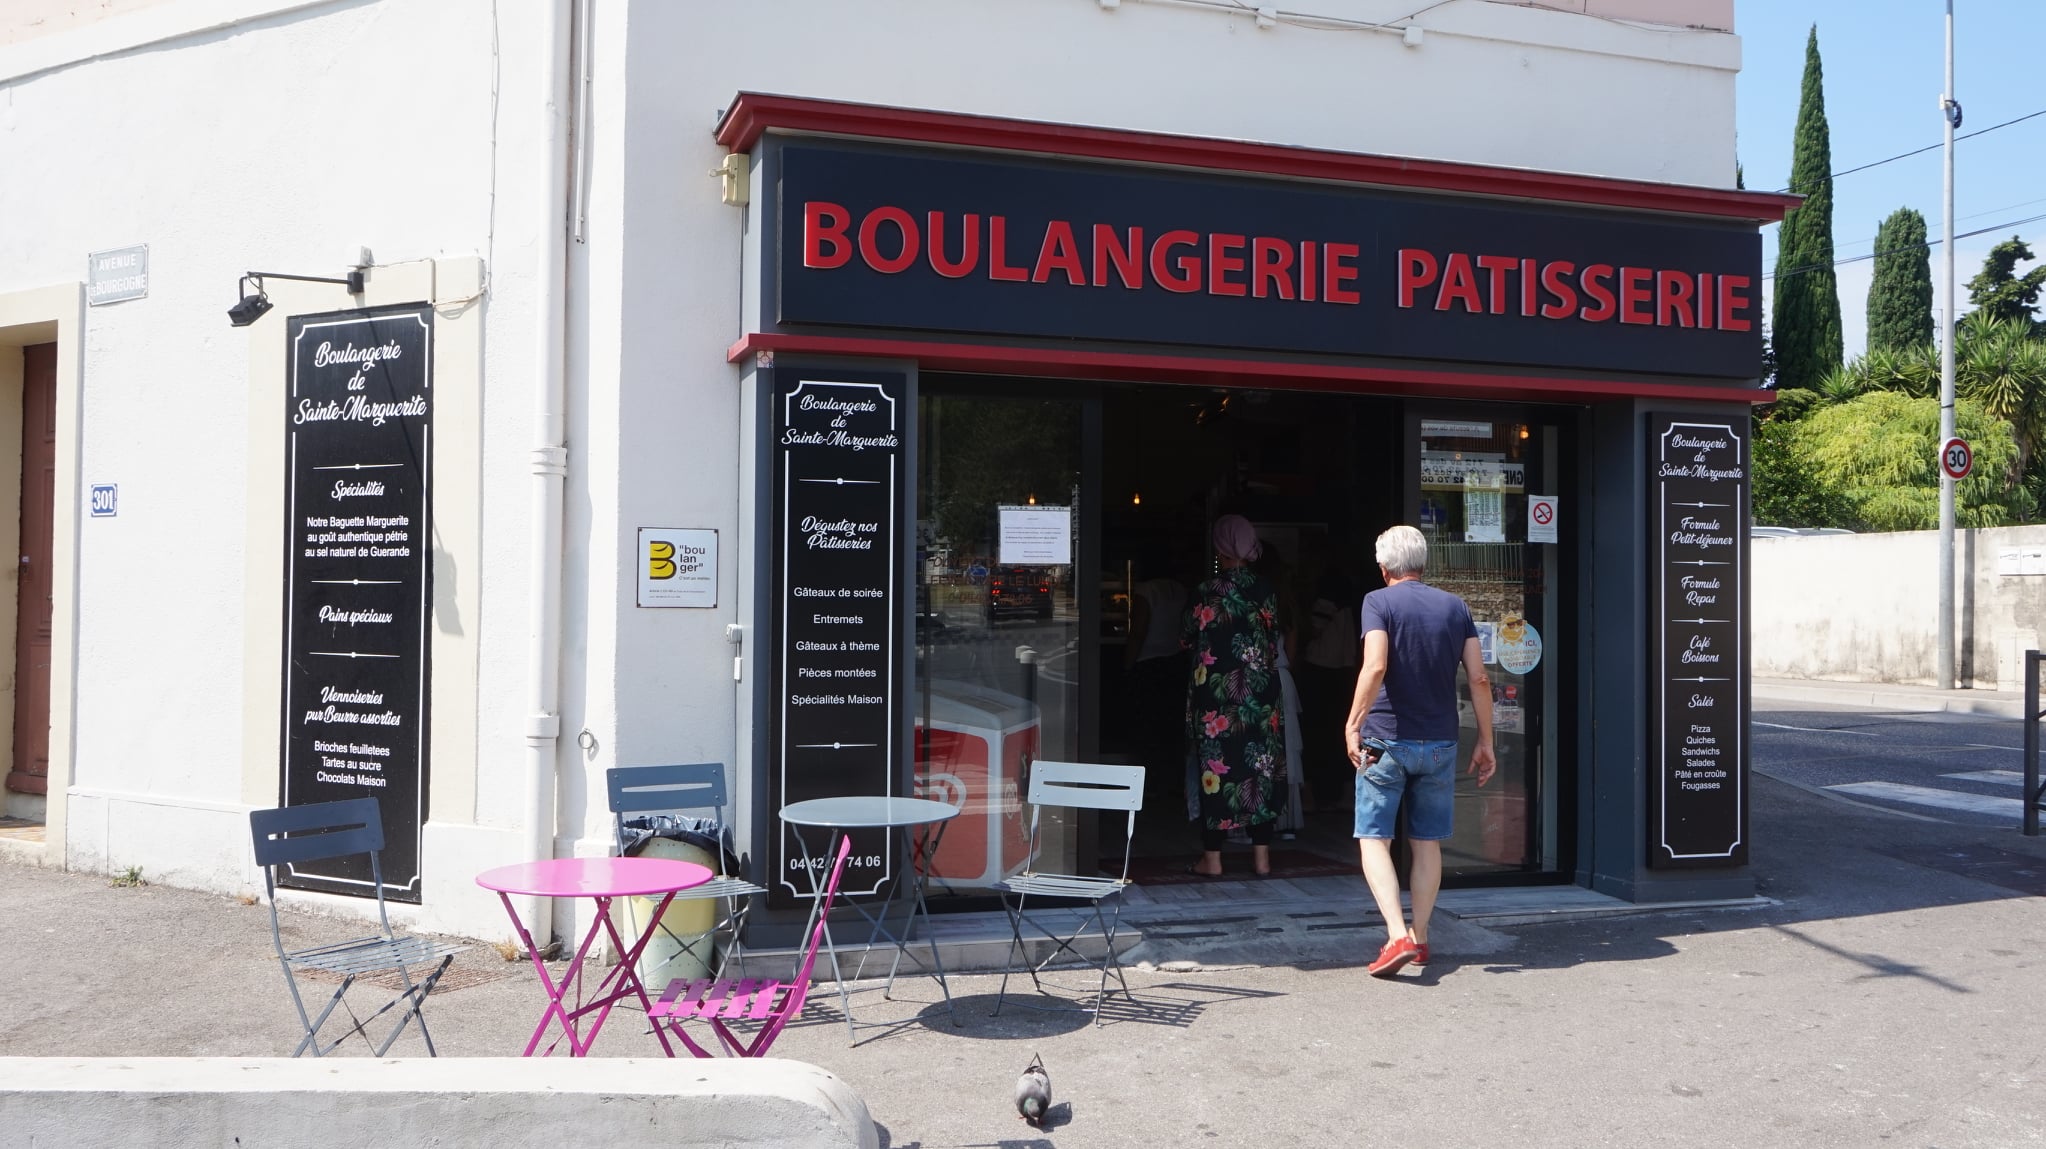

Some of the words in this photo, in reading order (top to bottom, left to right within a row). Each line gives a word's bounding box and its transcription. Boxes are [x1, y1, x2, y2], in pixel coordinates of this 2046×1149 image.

[99, 254, 136, 271] AVENUE
[803, 201, 1360, 304] BOULANGERIE
[1398, 249, 1751, 331] PATISSERIE
[96, 274, 146, 295] BOURGOGNE
[314, 339, 402, 371] Boulangerie
[347, 370, 365, 391] de
[293, 394, 427, 427] Sainte-Marguerite
[800, 394, 877, 416] Boulangerie
[831, 415, 847, 428] de
[781, 429, 899, 451] Sainte-Marguerite
[1671, 434, 1727, 452] Boulangerie
[1694, 451, 1706, 462] de
[1948, 450, 1967, 468] 30
[1658, 462, 1743, 482] Sainte-Marguerite
[331, 480, 385, 501] Spécialités
[94, 490, 113, 510] 301
[307, 517, 328, 527] Notre
[330, 516, 364, 529] Baguette
[366, 515, 409, 528] Marguerite
[801, 516, 856, 537] Dégustez
[858, 523, 878, 533] nos
[1681, 516, 1720, 530] Formule
[307, 534, 317, 542] au
[319, 532, 336, 544] goût
[338, 531, 383, 543] authentique
[385, 530, 408, 543] pétrie
[807, 534, 872, 550] Pâtisseries
[1671, 531, 1733, 549] Petit-déjeuner
[305, 549, 315, 557] au
[316, 547, 328, 557] sel
[330, 547, 356, 557] naturel
[358, 547, 368, 557] de
[680, 554, 696, 563] lan
[1681, 576, 1720, 589] Formule
[794, 587, 836, 597] Gâteaux
[838, 588, 850, 597] de
[853, 588, 883, 598] soirée
[1686, 590, 1716, 607] Repas
[319, 605, 348, 623] Pains
[350, 608, 392, 627] spéciaux
[813, 614, 863, 624] Entremets
[796, 641, 838, 651] Gâteaux
[840, 641, 847, 651] à
[850, 641, 880, 651] thème
[1690, 635, 1711, 651] Café
[1682, 650, 1719, 664] Boissons
[798, 668, 832, 678] Pièces
[835, 668, 877, 678] montées
[320, 685, 383, 704] Viennoiseries
[791, 694, 845, 707] Spécialités
[848, 694, 882, 704] Maison
[1688, 694, 1714, 708] Salés
[304, 710, 324, 725] pur
[323, 705, 359, 723] Beurre
[360, 710, 401, 725] assorties
[1691, 725, 1711, 733] Pizza
[314, 740, 348, 753] Brioches
[1686, 736, 1716, 745] Quiches
[1682, 747, 1720, 756] Sandwichs
[322, 756, 345, 768] Tartes
[347, 761, 357, 769] au
[359, 761, 381, 771] sucre
[1686, 759, 1716, 767] Salades
[317, 771, 355, 784] Chocolats
[357, 775, 386, 787] Maison
[1675, 770, 1692, 779] Pâté
[1704, 769, 1727, 778] croûte
[1681, 781, 1721, 792] Fougasses
[790, 858, 806, 870] 04
[810, 857, 824, 869] 42
[847, 856, 862, 868] 74
[866, 855, 881, 867] 06
